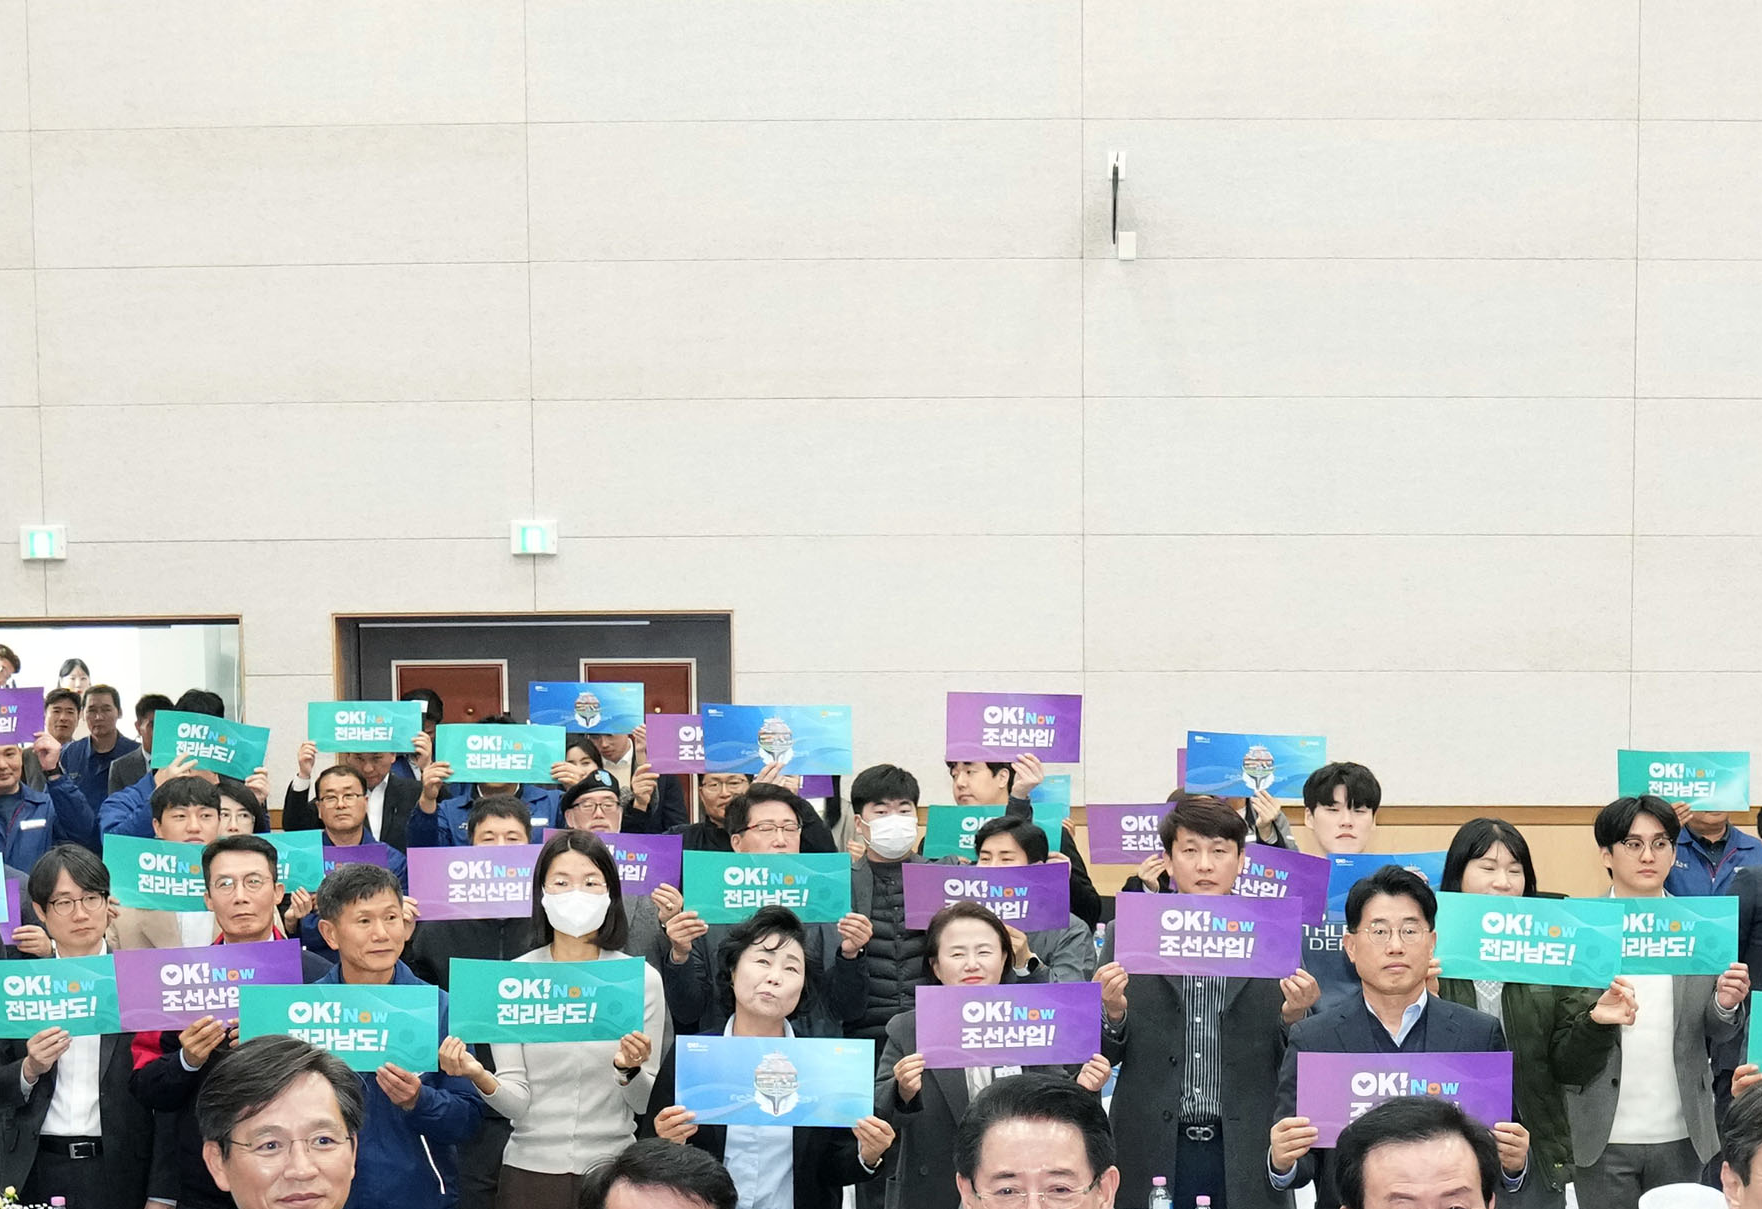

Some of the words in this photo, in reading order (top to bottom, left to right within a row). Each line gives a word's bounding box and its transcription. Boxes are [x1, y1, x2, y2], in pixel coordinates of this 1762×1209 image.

[335, 711, 366, 725] OK!
[984, 706, 1024, 725] OK!
[177, 722, 210, 740] OK!
[335, 727, 393, 741] 전라남도!
[982, 728, 1055, 748] 조선산업!
[176, 740, 235, 763] 전라남도!
[466, 735, 502, 751] OK!
[466, 753, 534, 769] 전라남도!
[1649, 762, 1685, 778] OK!
[1648, 780, 1716, 798] 전라남도!
[1121, 815, 1158, 832] OK!
[139, 852, 177, 871] OK!
[448, 861, 491, 879] OK!
[724, 867, 767, 886] OK!
[448, 882, 531, 902] 조선산업!
[723, 888, 809, 908] 전라남도!
[944, 879, 987, 898] OK!
[1161, 910, 1210, 932] OK!
[1482, 912, 1531, 936] OK!
[1159, 935, 1254, 958] 조선산업!
[1479, 938, 1576, 966] 전라남도!
[160, 963, 209, 985] OK!
[3, 976, 51, 996] OK!
[498, 978, 551, 999] OK!
[6, 997, 97, 1021] 전라남도!
[289, 1002, 340, 1023] OK!
[497, 1002, 597, 1025] 전라남도!
[962, 1001, 1012, 1022] OK!
[962, 1024, 1056, 1049] 조선산업!
[1351, 1072, 1409, 1096] OK!
